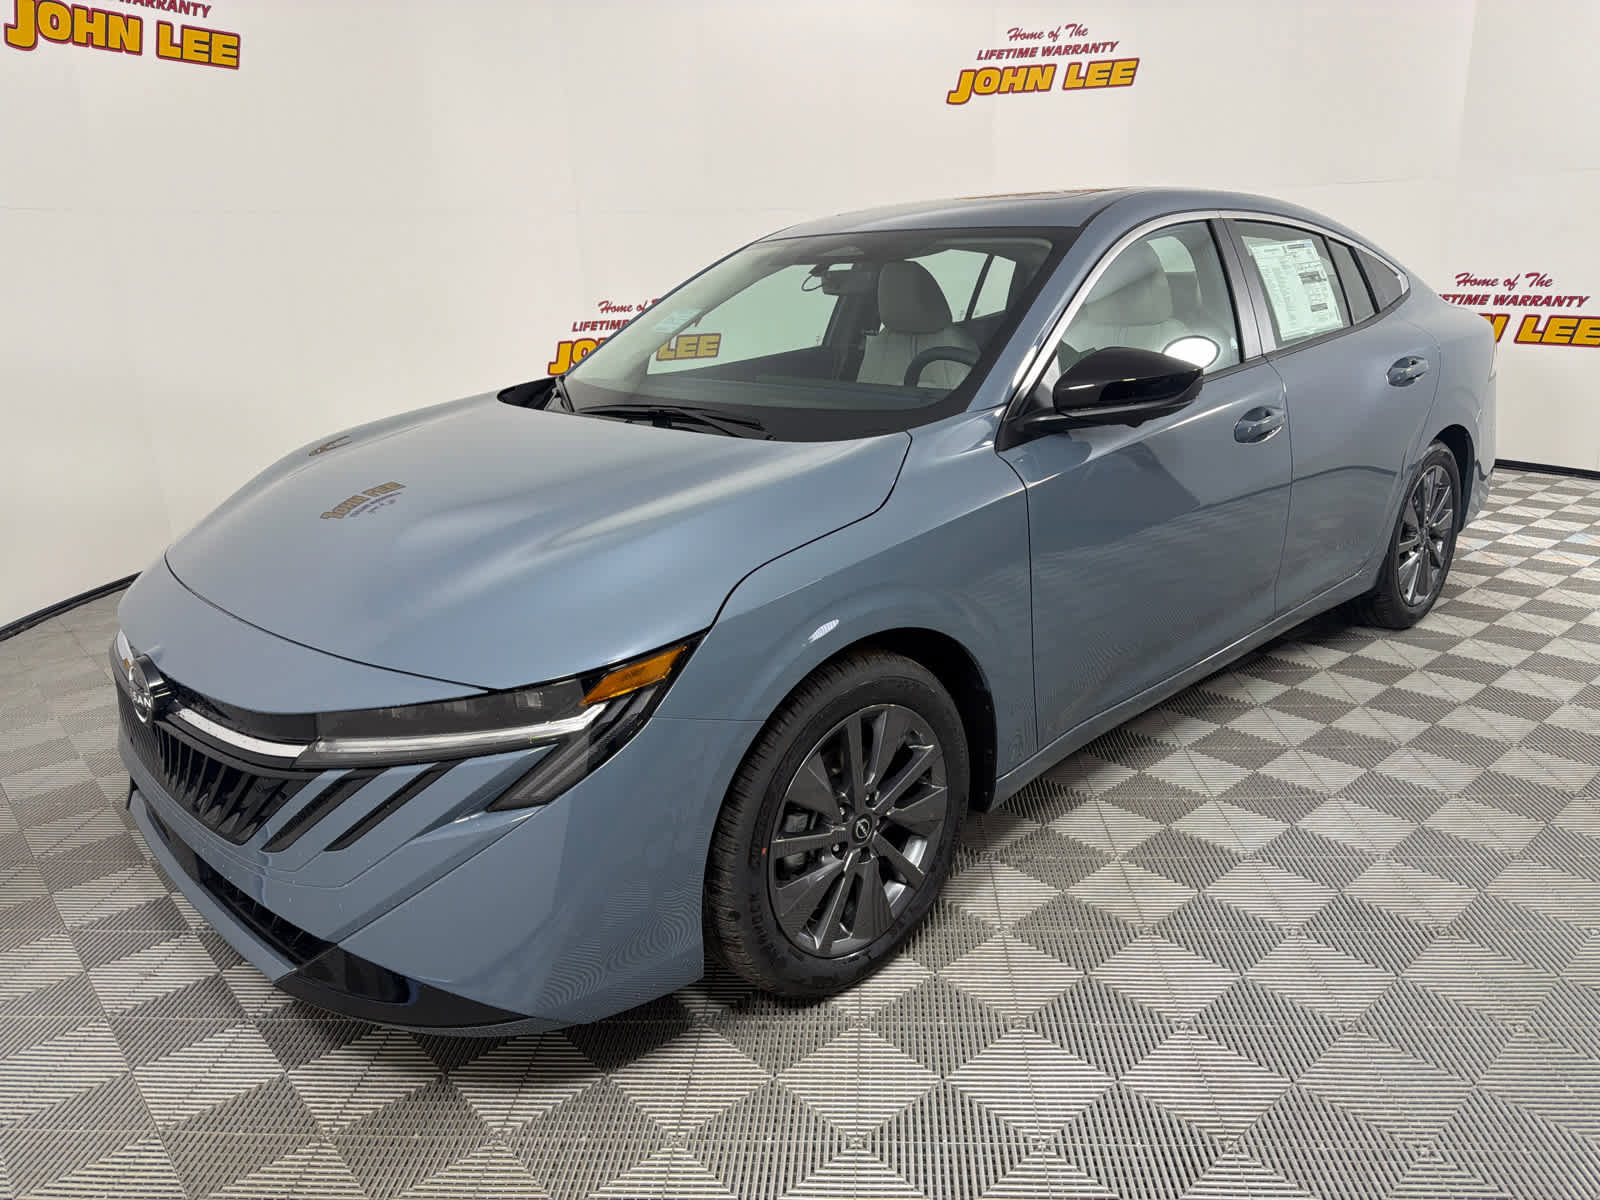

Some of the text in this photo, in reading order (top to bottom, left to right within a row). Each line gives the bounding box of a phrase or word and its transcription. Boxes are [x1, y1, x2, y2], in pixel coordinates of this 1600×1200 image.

[4, 0, 241, 70] JOHN LEE
[1007, 24, 1088, 42] Home of The
[976, 41, 1120, 61] LIFETIME WARRANTY
[946, 57, 1140, 105] JOHN LEE
[1455, 272, 1553, 291] Home of The
[598, 300, 633, 313] Home
[1493, 295, 1591, 308] WARRANTY
[1513, 313, 1600, 348] LEE
[656, 333, 721, 361] LEE
